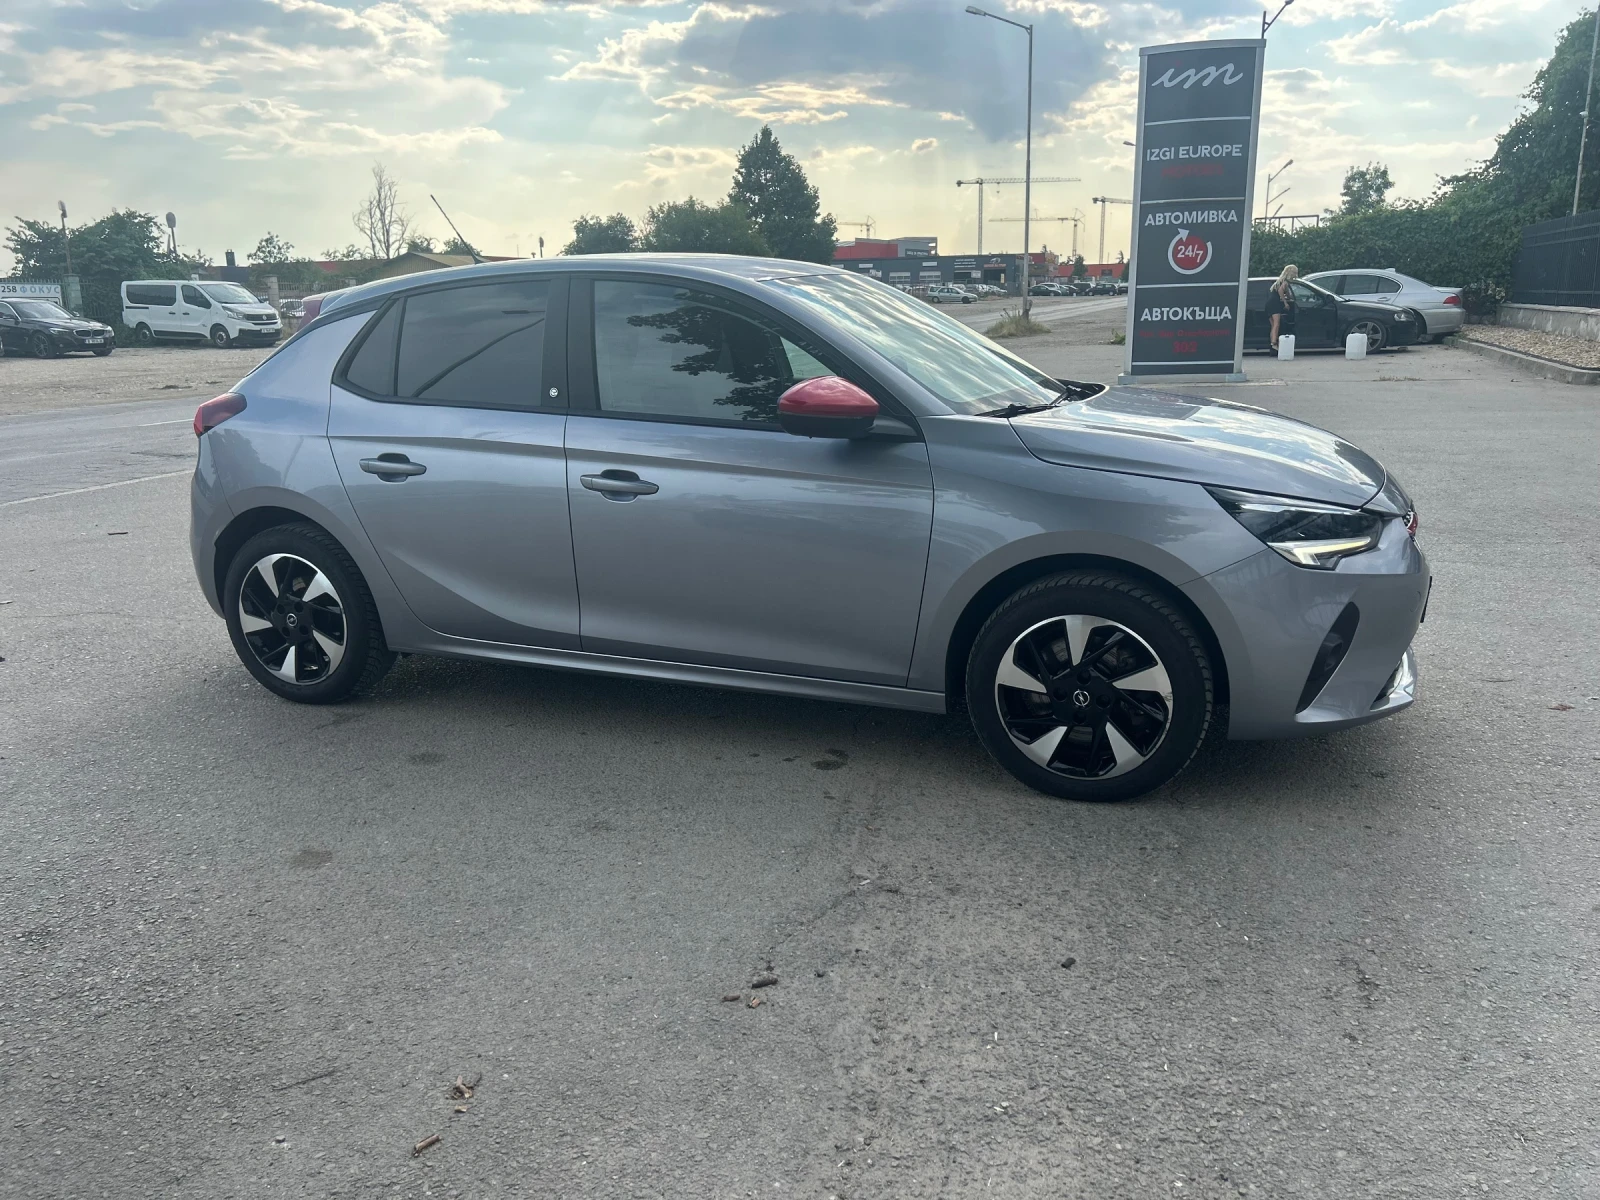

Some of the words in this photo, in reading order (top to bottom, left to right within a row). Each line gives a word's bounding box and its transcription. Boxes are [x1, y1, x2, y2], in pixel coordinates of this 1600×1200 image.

[1146, 146, 1175, 161] IZGI
[1178, 144, 1243, 159] EUROPE
[1144, 209, 1238, 226] АВТОМИВКА
[1177, 244, 1203, 263] 24/7
[1140, 306, 1232, 322] АВТОКЪЩА
